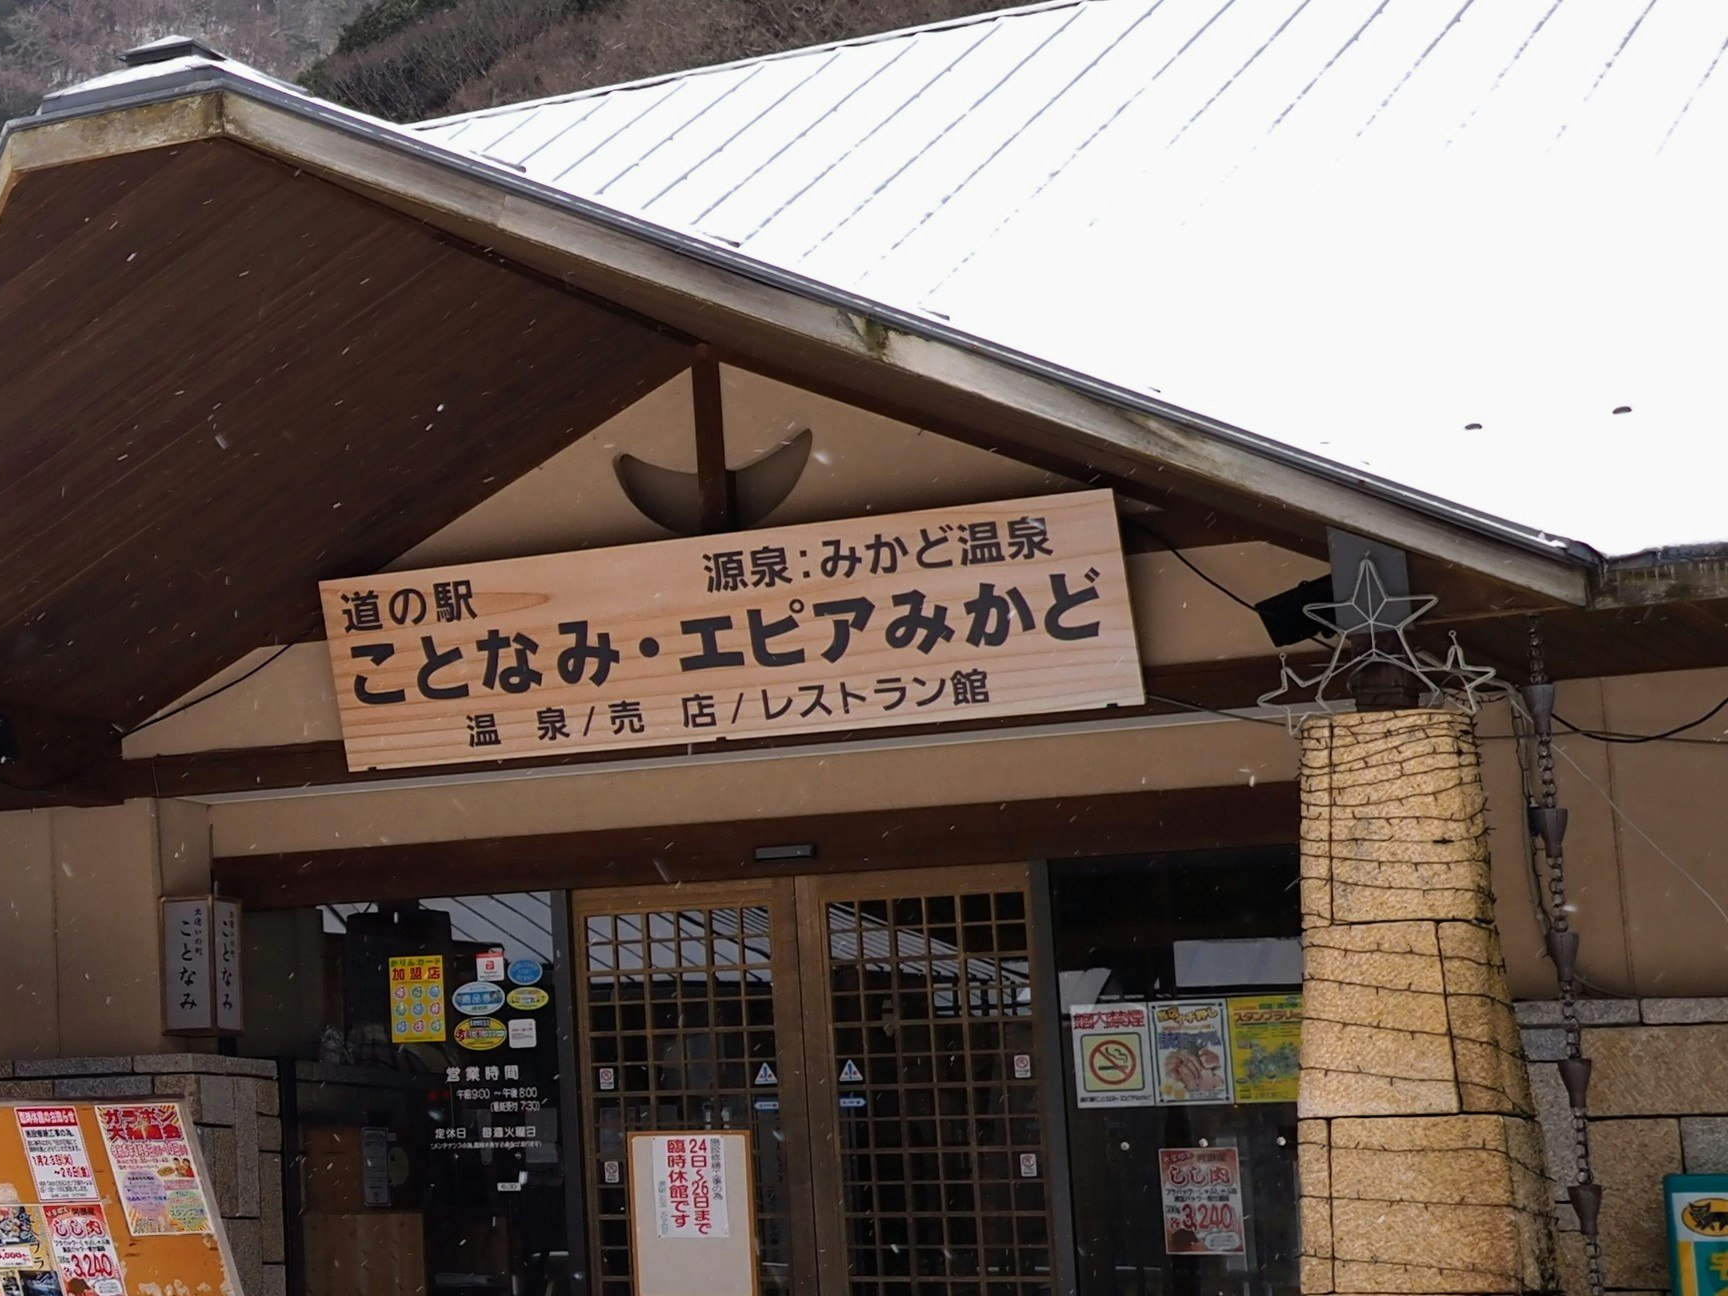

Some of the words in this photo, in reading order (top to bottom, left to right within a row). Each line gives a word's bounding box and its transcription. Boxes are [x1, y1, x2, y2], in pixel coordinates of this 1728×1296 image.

[702, 515, 1054, 594] 源泉：みかど温泉
[340, 579, 478, 634] 道の駅
[349, 567, 1102, 706] ことなみ・エピアみかど
[178, 920, 197, 1011] ことなみ
[391, 966, 441, 981] 加盟店
[446, 1065, 519, 1082] 営業時間
[435, 1128, 467, 1139] 定休日
[482, 1126, 536, 1138] 毎週火曜日
[667, 1139, 690, 1228] 臨時休館です
[52, 1219, 103, 1237] しし肉
[70, 1253, 113, 1278] 3,240
